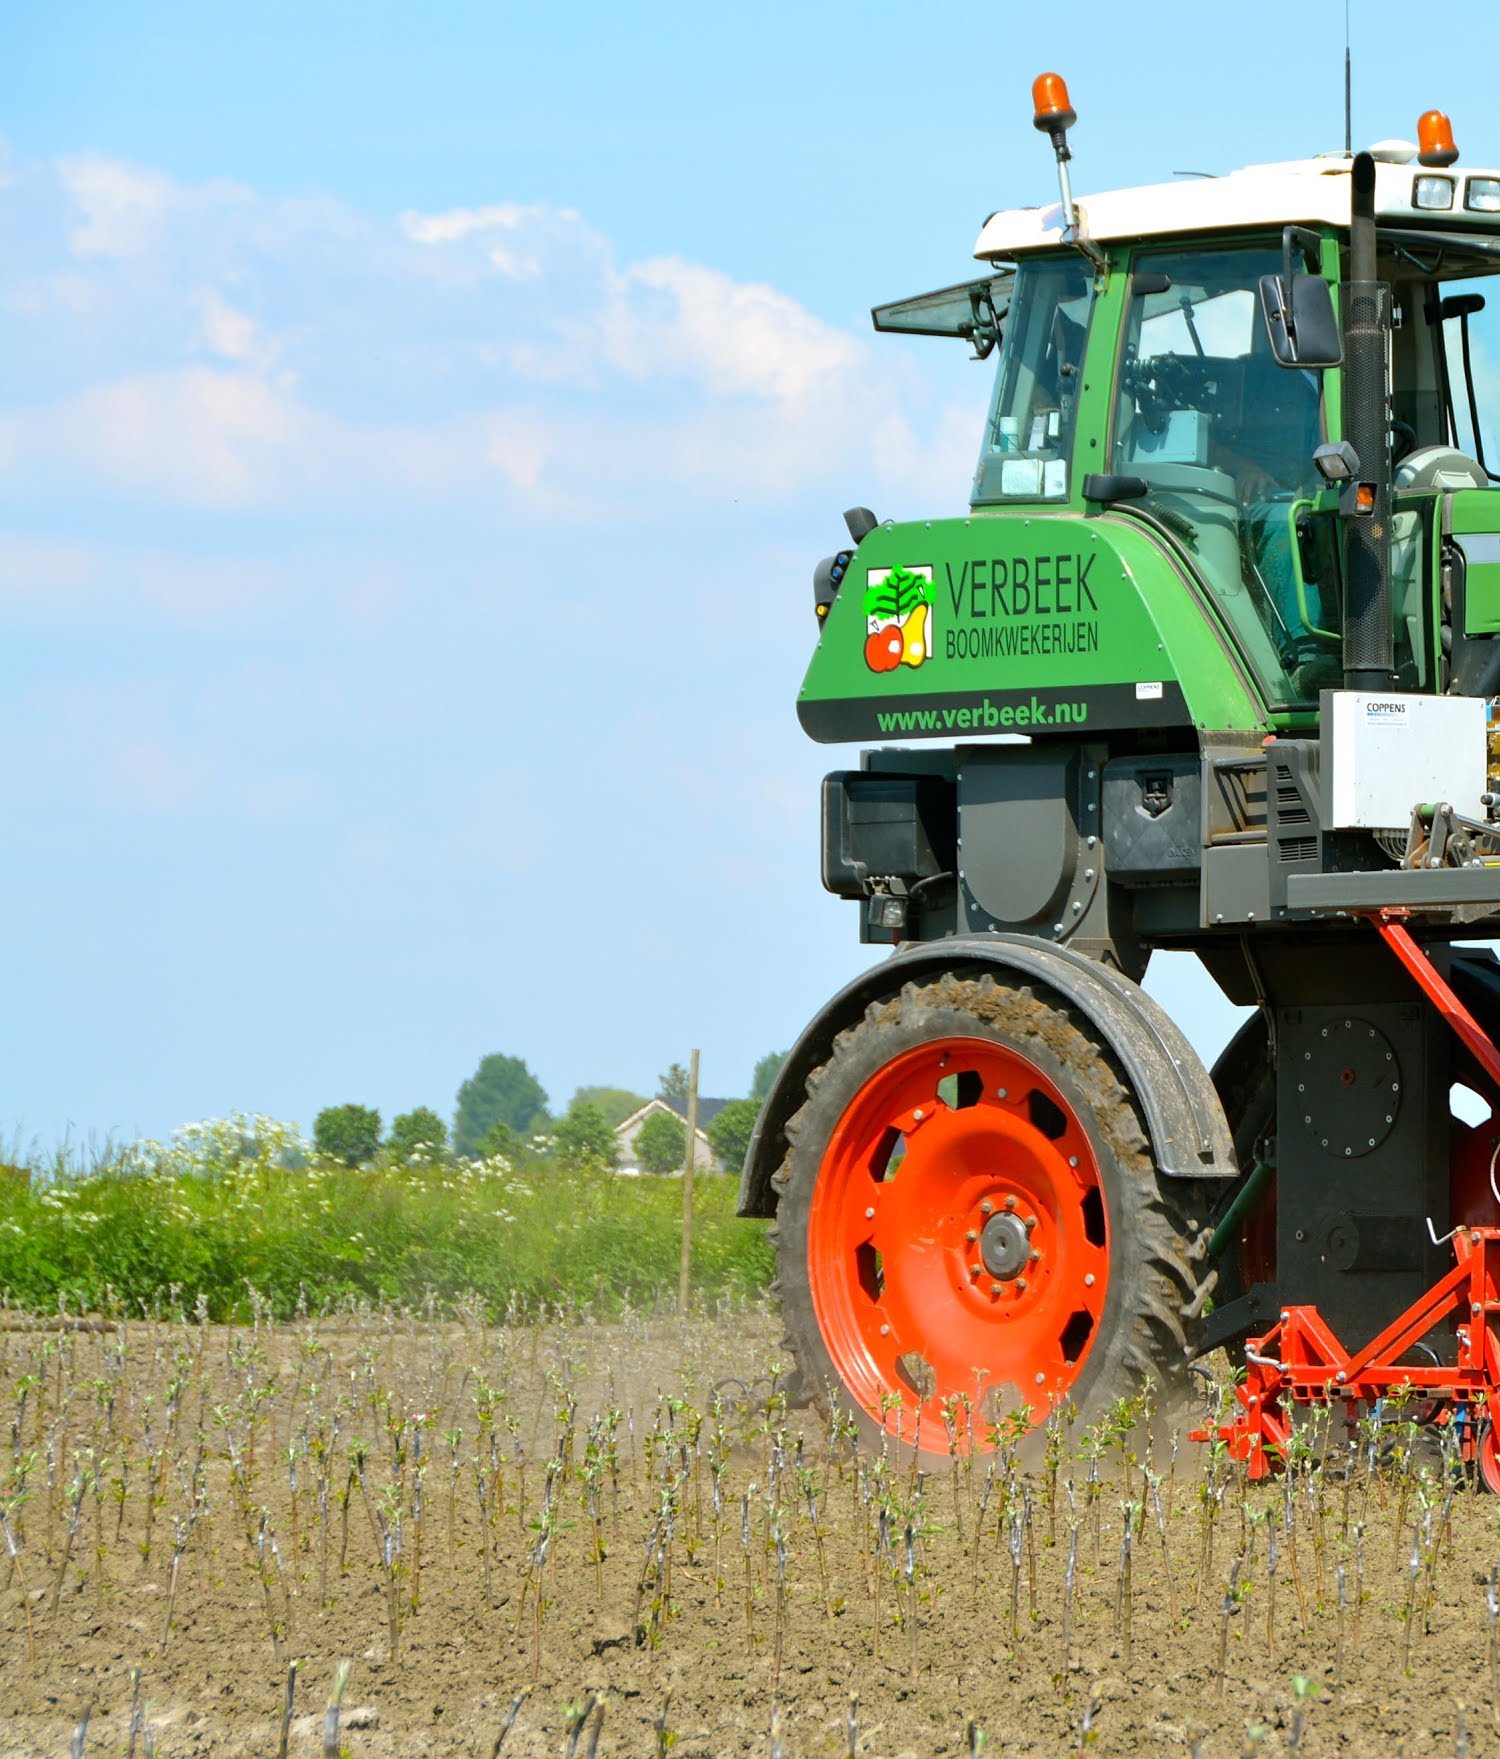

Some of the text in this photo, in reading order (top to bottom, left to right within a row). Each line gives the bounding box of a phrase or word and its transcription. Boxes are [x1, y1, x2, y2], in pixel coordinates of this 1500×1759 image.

[945, 553, 1098, 620] VERBEEK
[946, 621, 1098, 660] BOOMKWEKERIJEN
[877, 696, 1088, 732] www.verbeek.nu
[1366, 702, 1406, 713] COPPENS
